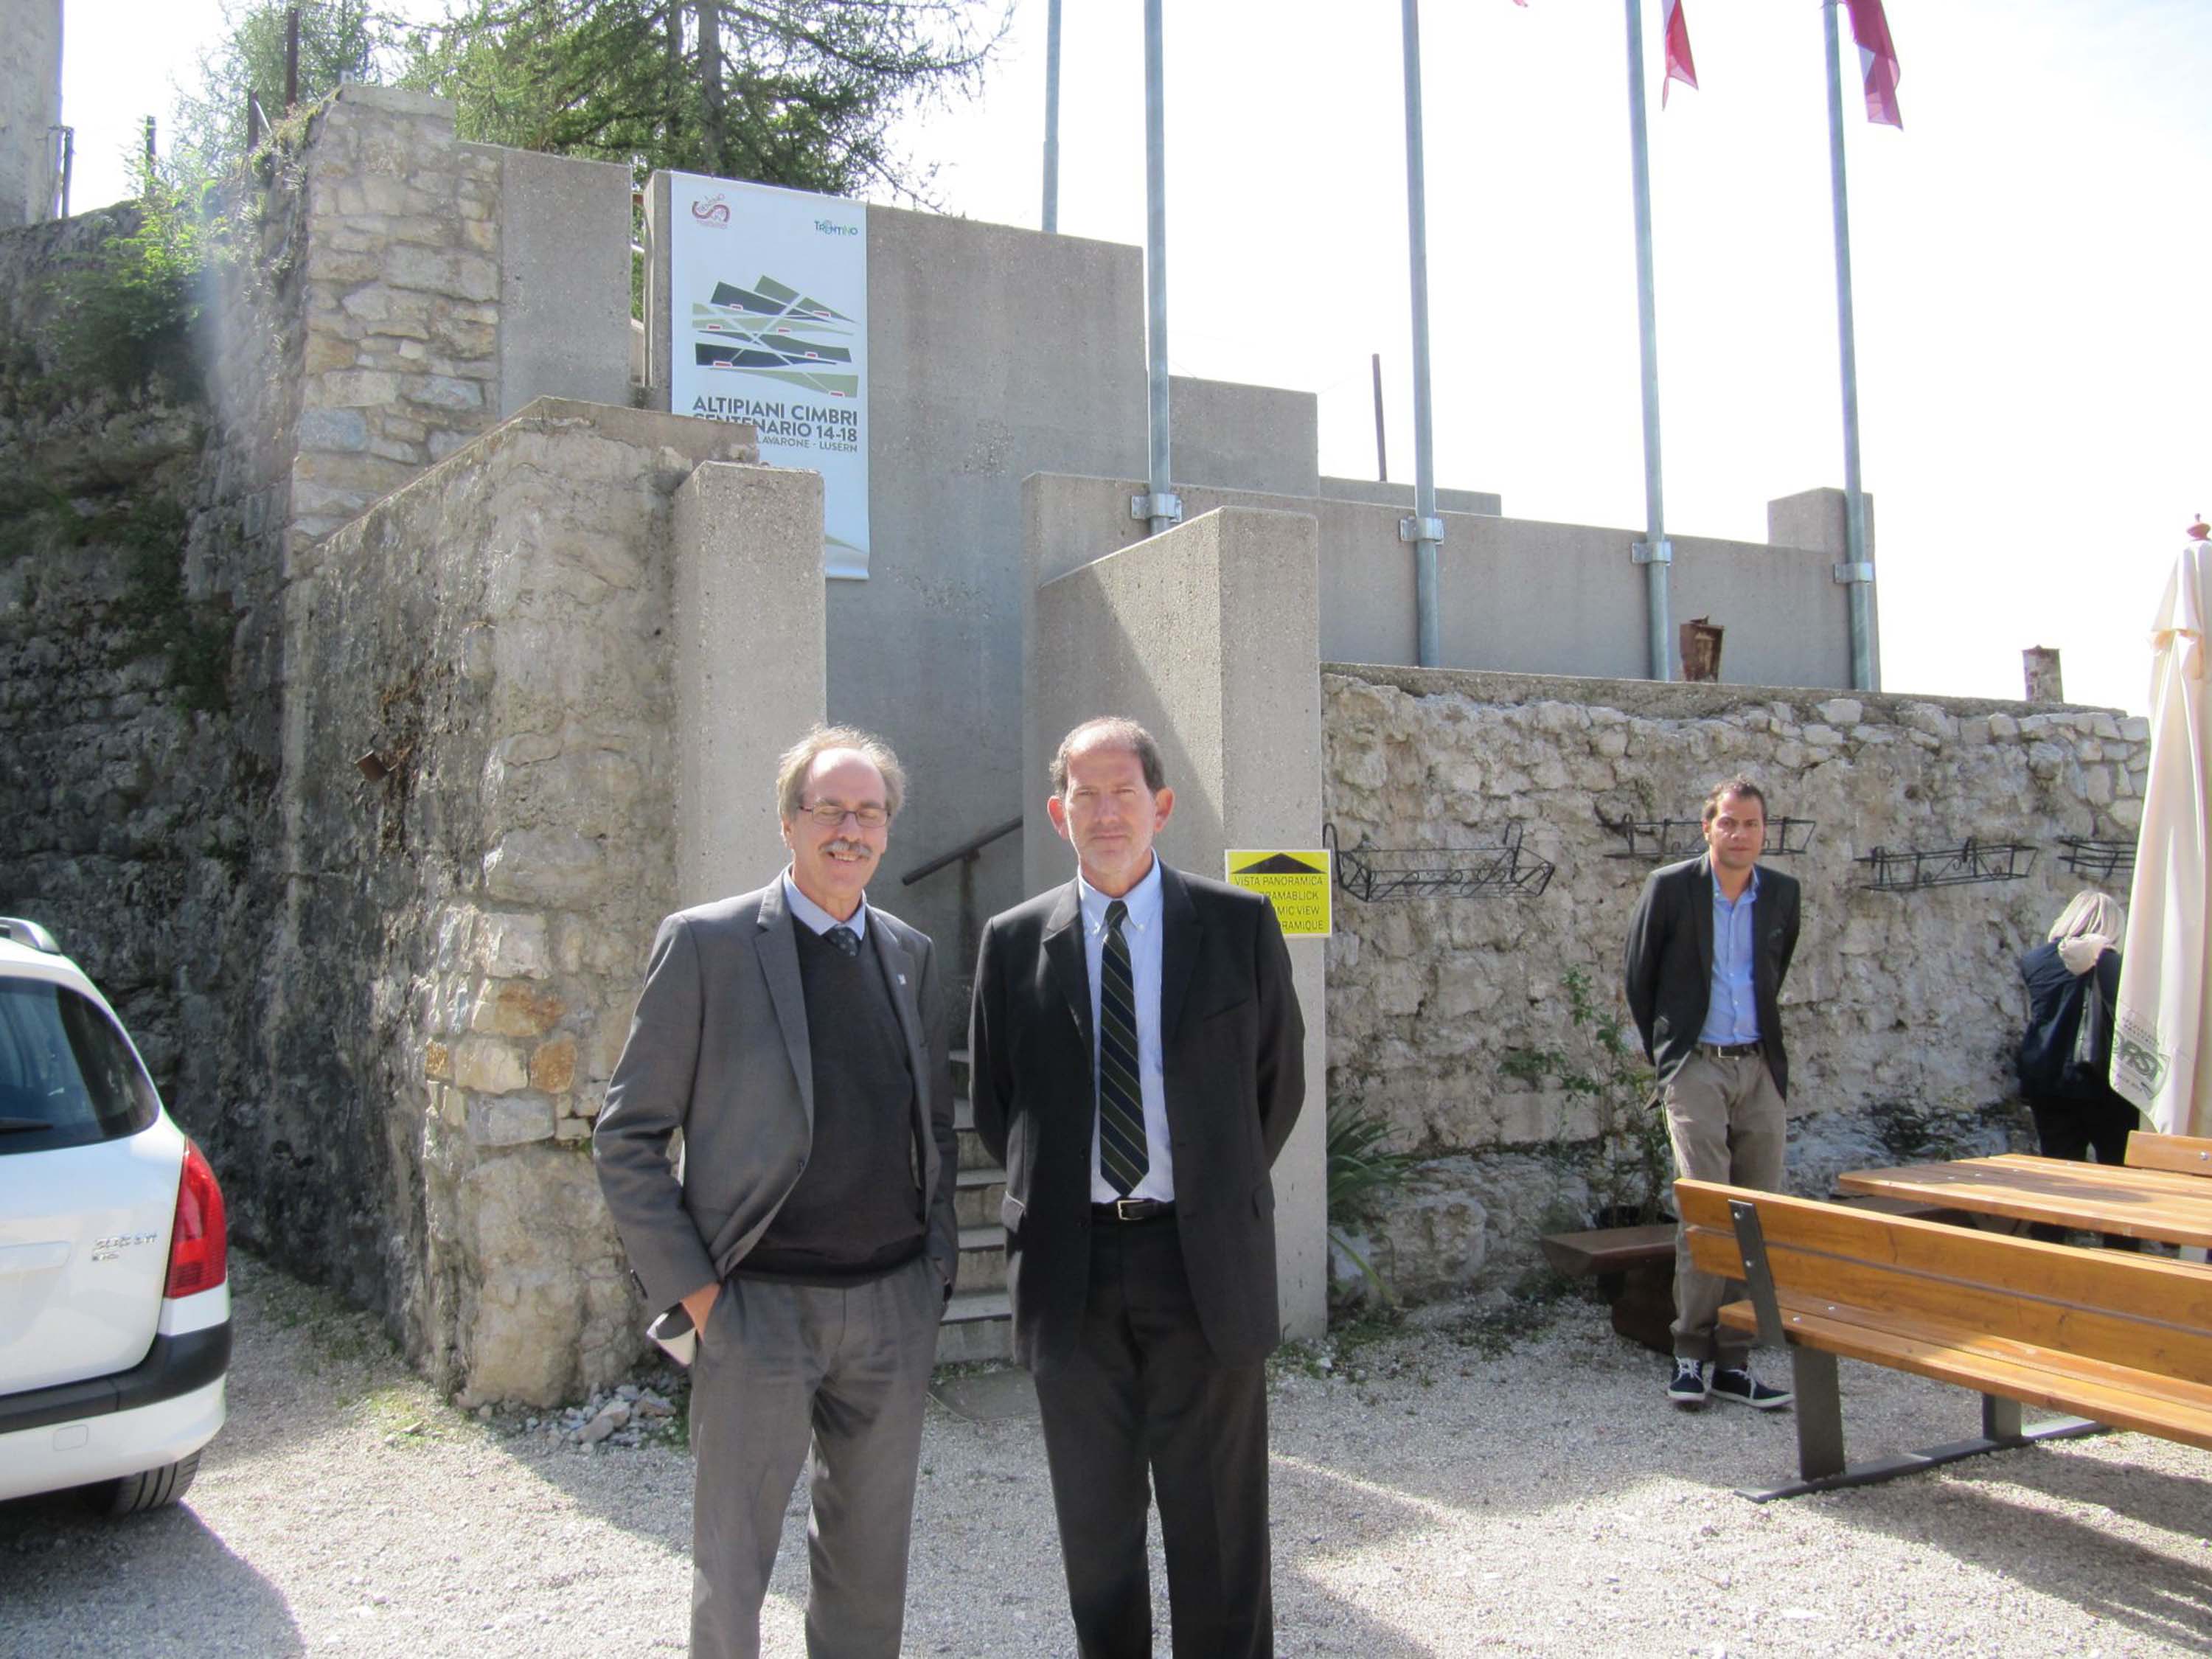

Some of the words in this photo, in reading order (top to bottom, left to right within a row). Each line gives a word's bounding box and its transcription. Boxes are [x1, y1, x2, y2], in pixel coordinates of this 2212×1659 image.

[814, 220, 858, 235] TRENTINO
[692, 395, 785, 419] ALTIPIANI
[791, 405, 858, 427] CIMBRI
[816, 425, 858, 442] 14-18
[1234, 876, 1260, 886] VISTA
[1262, 876, 1323, 886] PANORAMICA
[1297, 906, 1320, 916] VIEW
